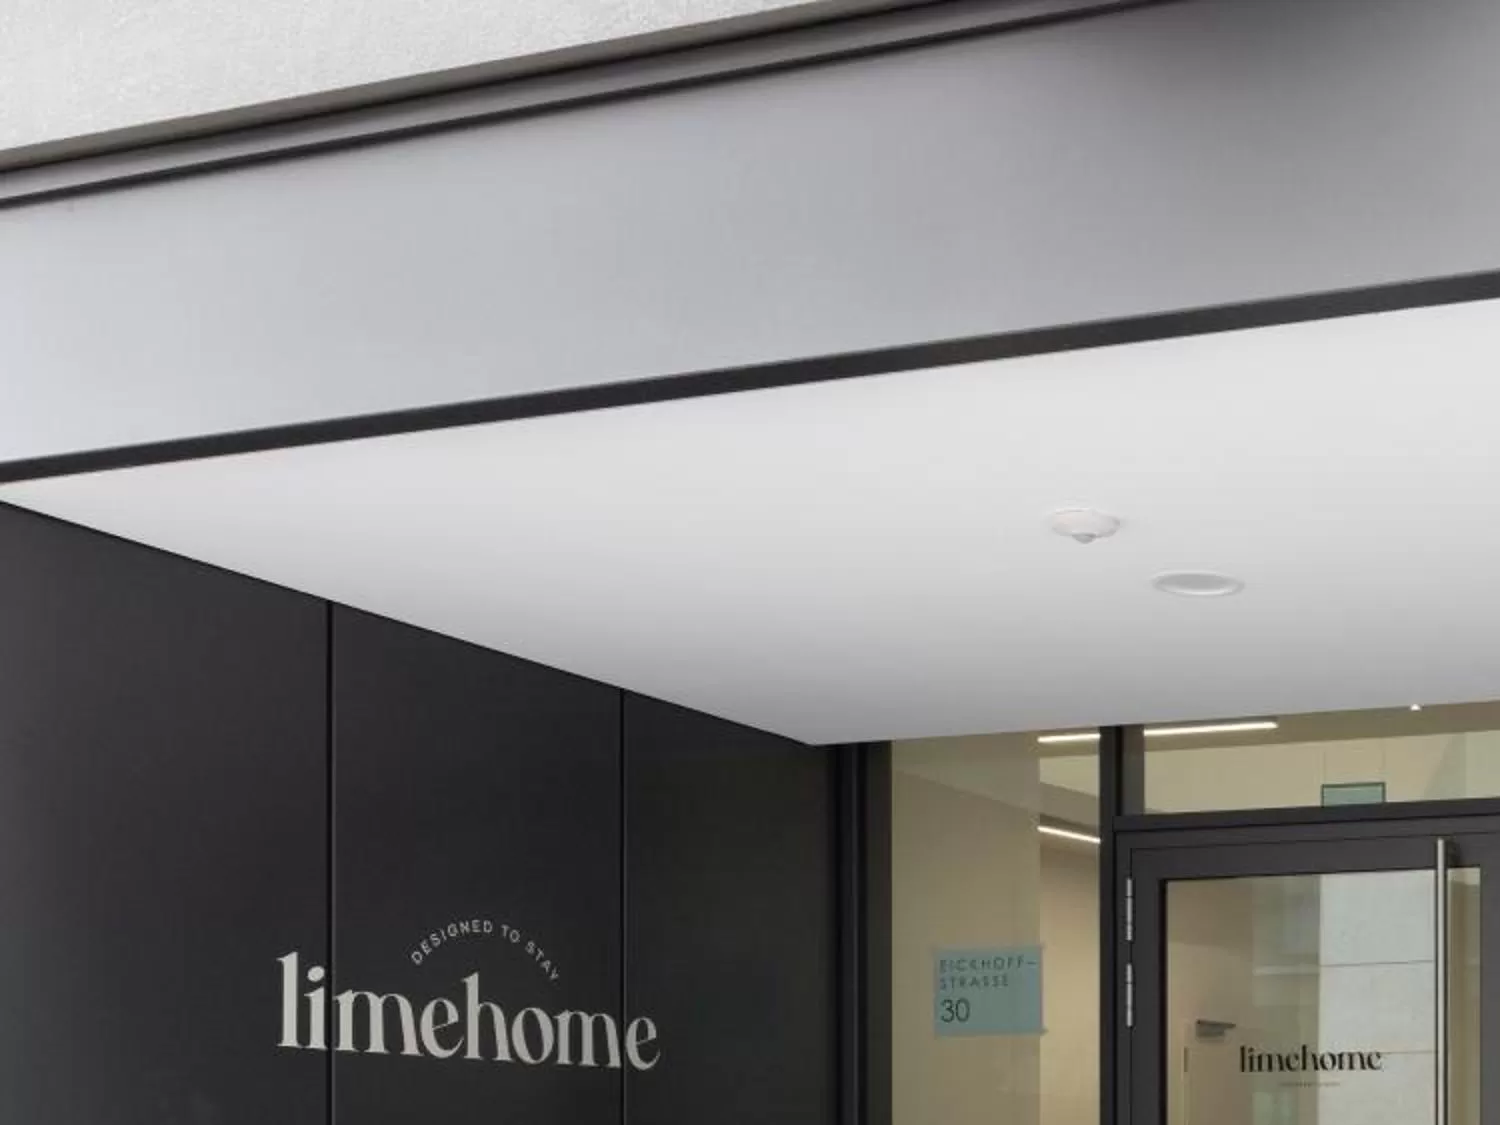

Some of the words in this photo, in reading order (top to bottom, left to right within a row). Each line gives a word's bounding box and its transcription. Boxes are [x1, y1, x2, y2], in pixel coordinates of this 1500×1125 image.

[410, 919, 493, 965] DESIGNED
[501, 923, 521, 943] TO
[525, 940, 559, 980] STAY
[939, 974, 1008, 990] STRASSE
[277, 951, 661, 1071] limehome
[940, 997, 970, 1023] 30
[1239, 1044, 1384, 1073] limehome
